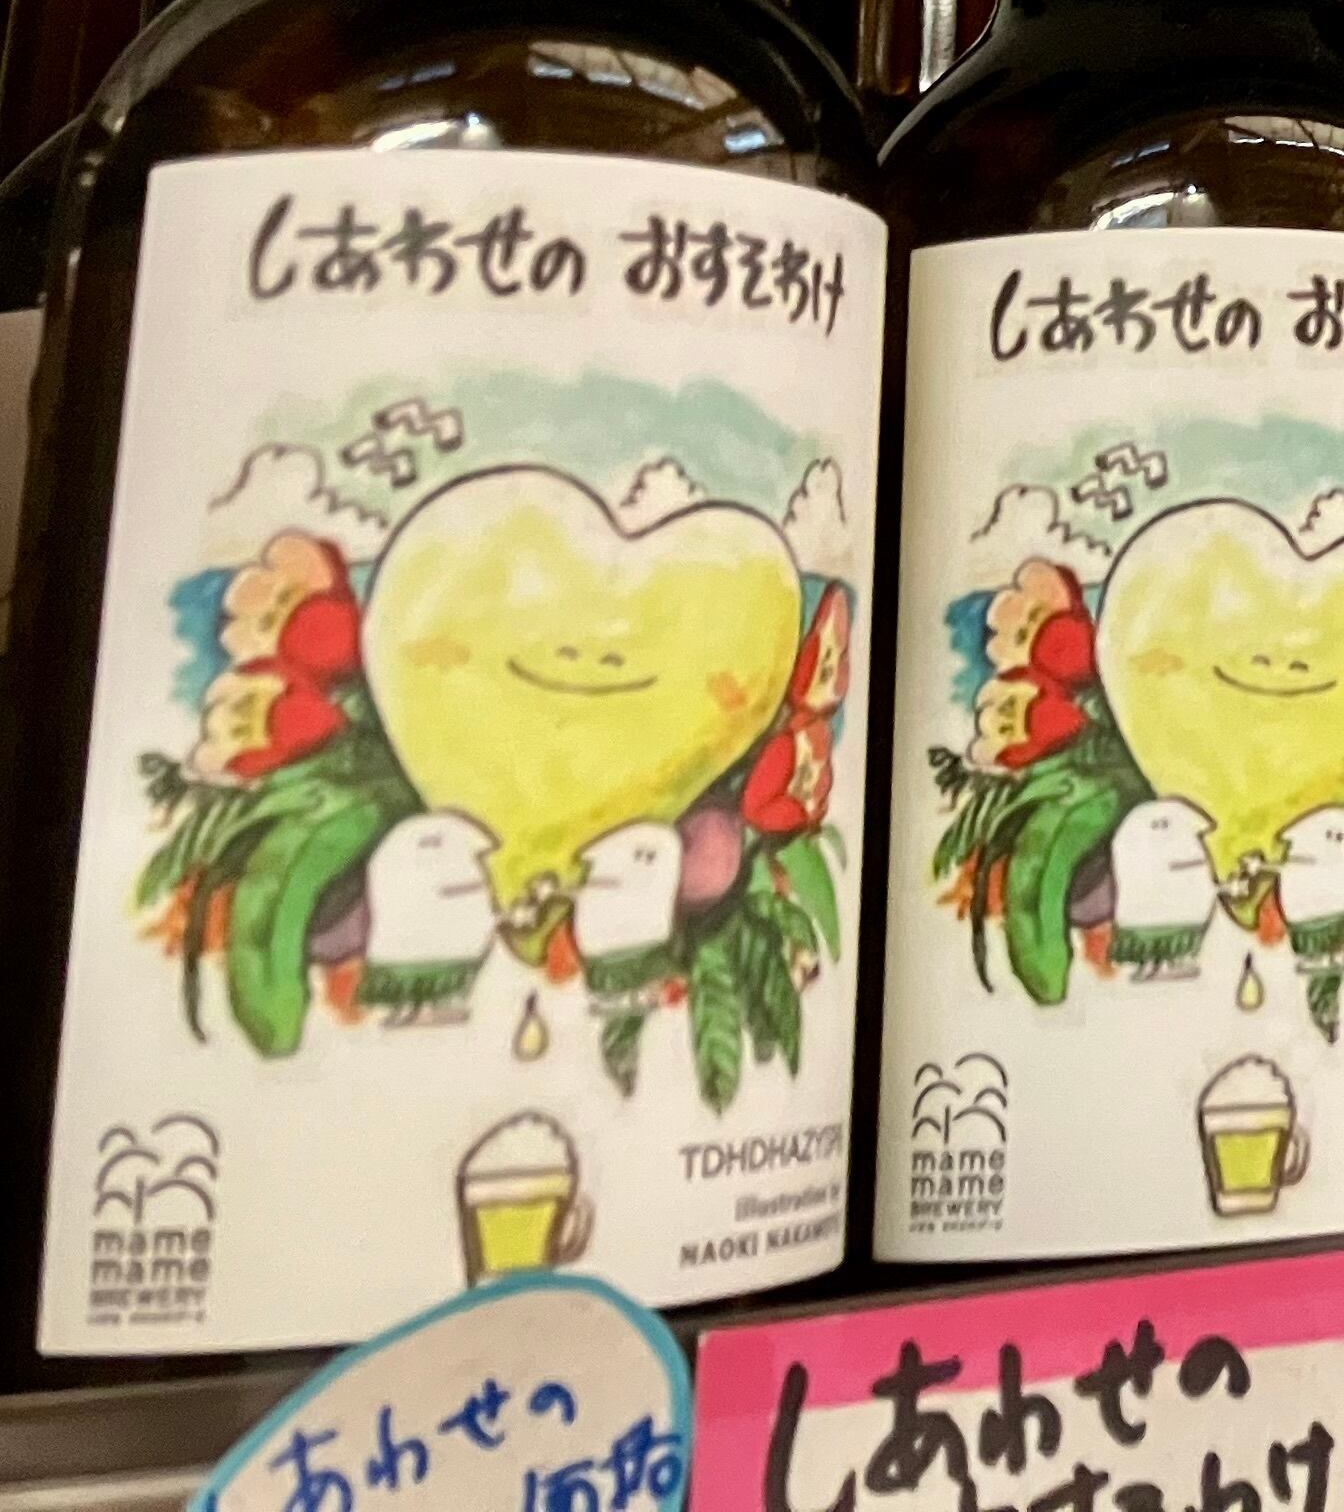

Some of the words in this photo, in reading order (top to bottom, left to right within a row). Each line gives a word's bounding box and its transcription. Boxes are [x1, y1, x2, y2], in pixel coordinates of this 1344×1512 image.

[249, 193, 586, 300] しあわせの
[990, 268, 1262, 362] しあわせの
[910, 1149, 1005, 1171] mame
[910, 1173, 1004, 1197] mame
[94, 1228, 211, 1257] mame
[679, 1231, 759, 1269] NAOKI
[92, 1257, 209, 1285] mame
